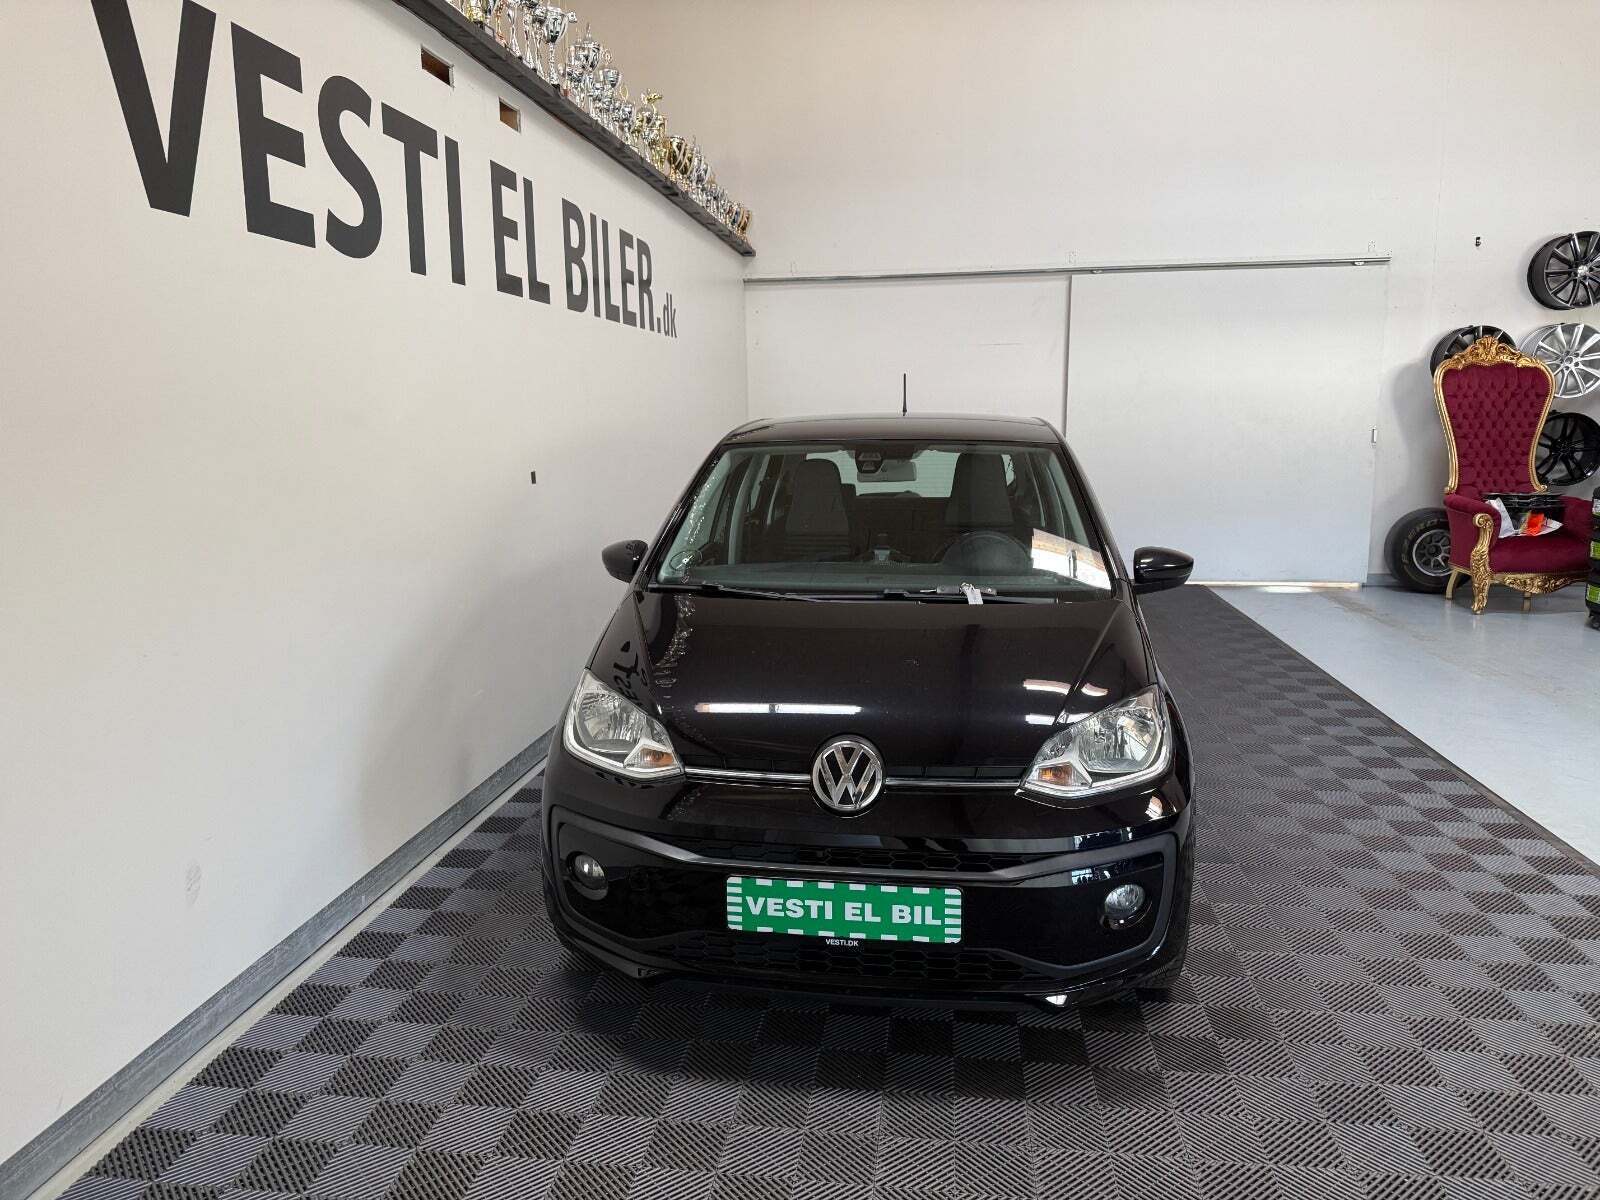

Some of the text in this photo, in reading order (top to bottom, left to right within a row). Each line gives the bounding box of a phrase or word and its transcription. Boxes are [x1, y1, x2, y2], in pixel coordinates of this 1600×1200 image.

[91, 0, 466, 285] VESTI
[490, 160, 550, 304] EL
[745, 896, 942, 925] VESTI EL BIL
